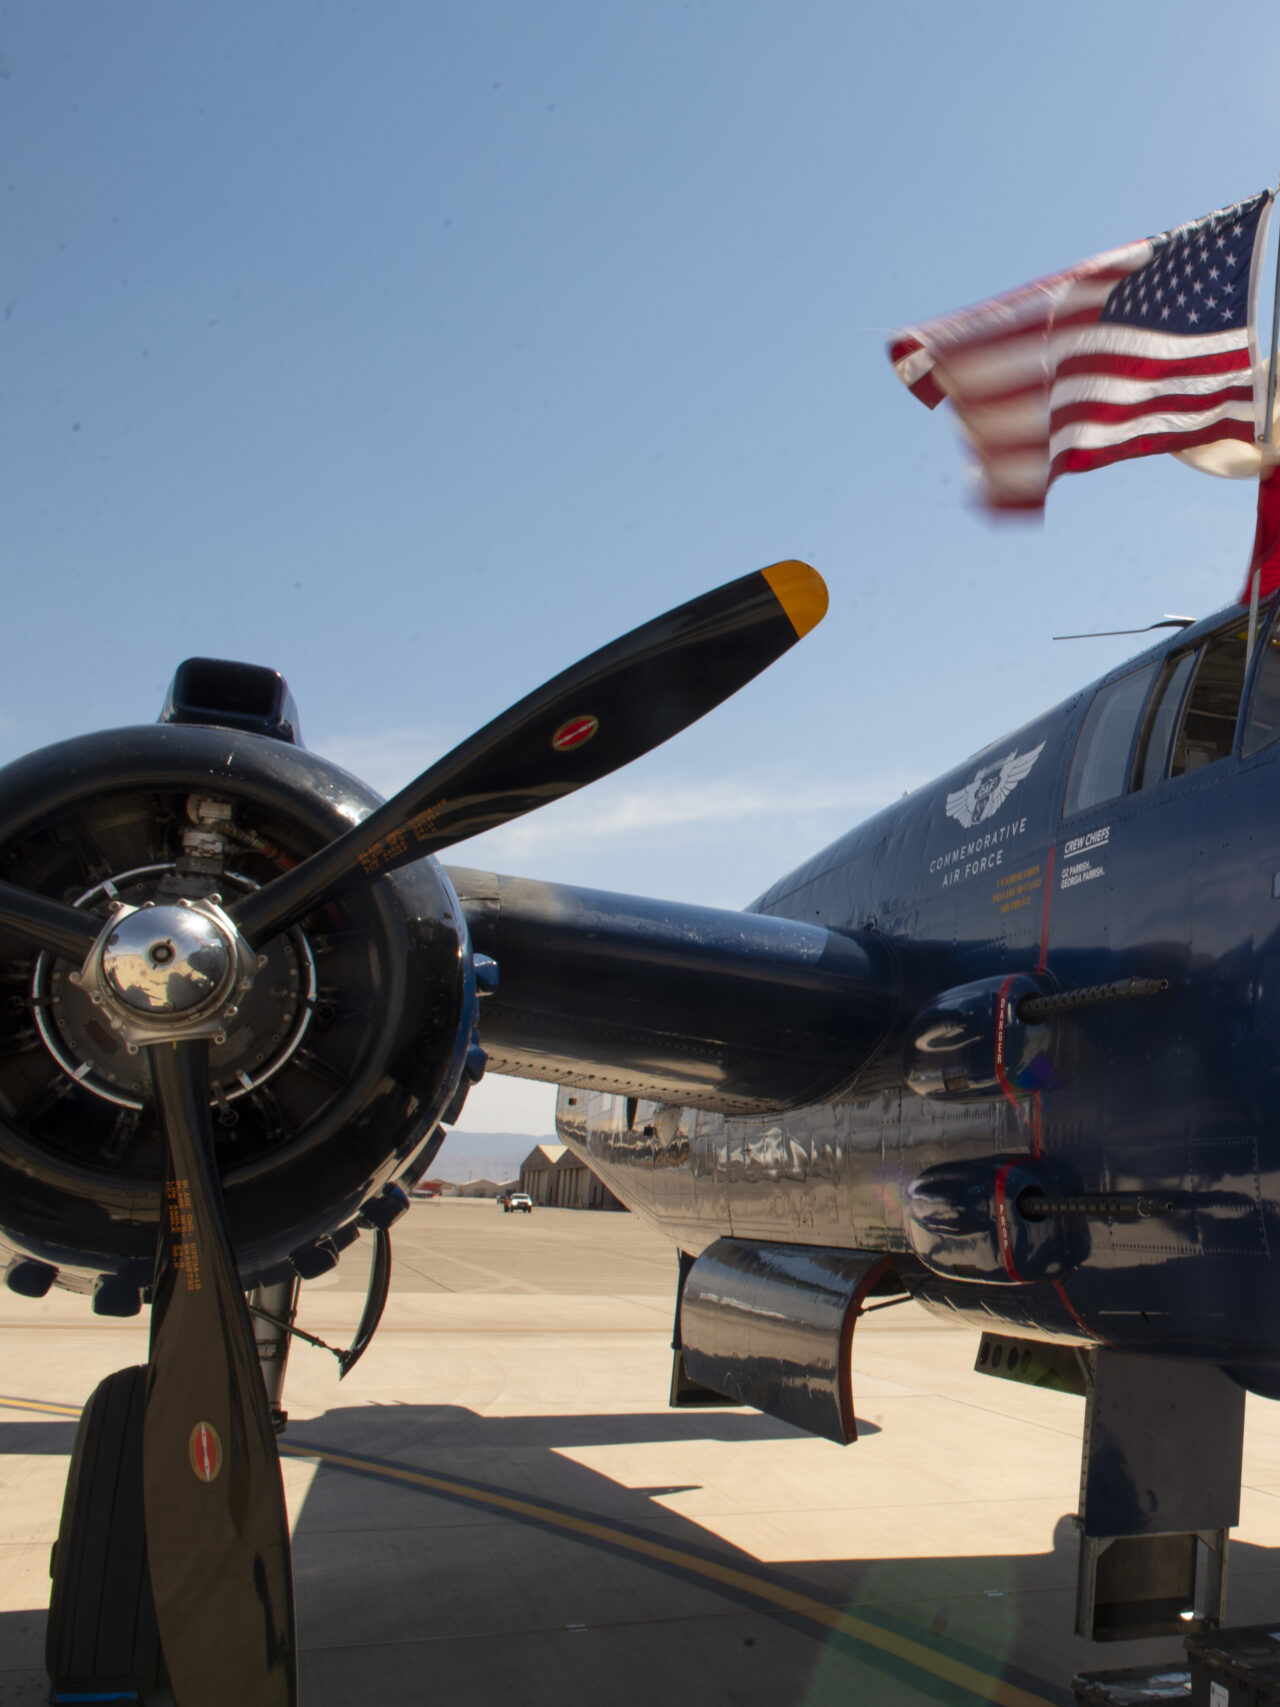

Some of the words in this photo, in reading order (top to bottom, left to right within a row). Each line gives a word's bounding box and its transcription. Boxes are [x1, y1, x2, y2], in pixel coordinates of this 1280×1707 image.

[929, 817, 1027, 873] COMMEMORATIVE
[1064, 836, 1085, 854] CREW
[1085, 825, 1110, 846] CHIEFS
[942, 868, 960, 888] AIR
[965, 849, 1004, 878] FORCE
[1061, 875, 1081, 889] GEORGIA
[997, 997, 1006, 1064] DANGER
[999, 1204, 1009, 1250] PROP
